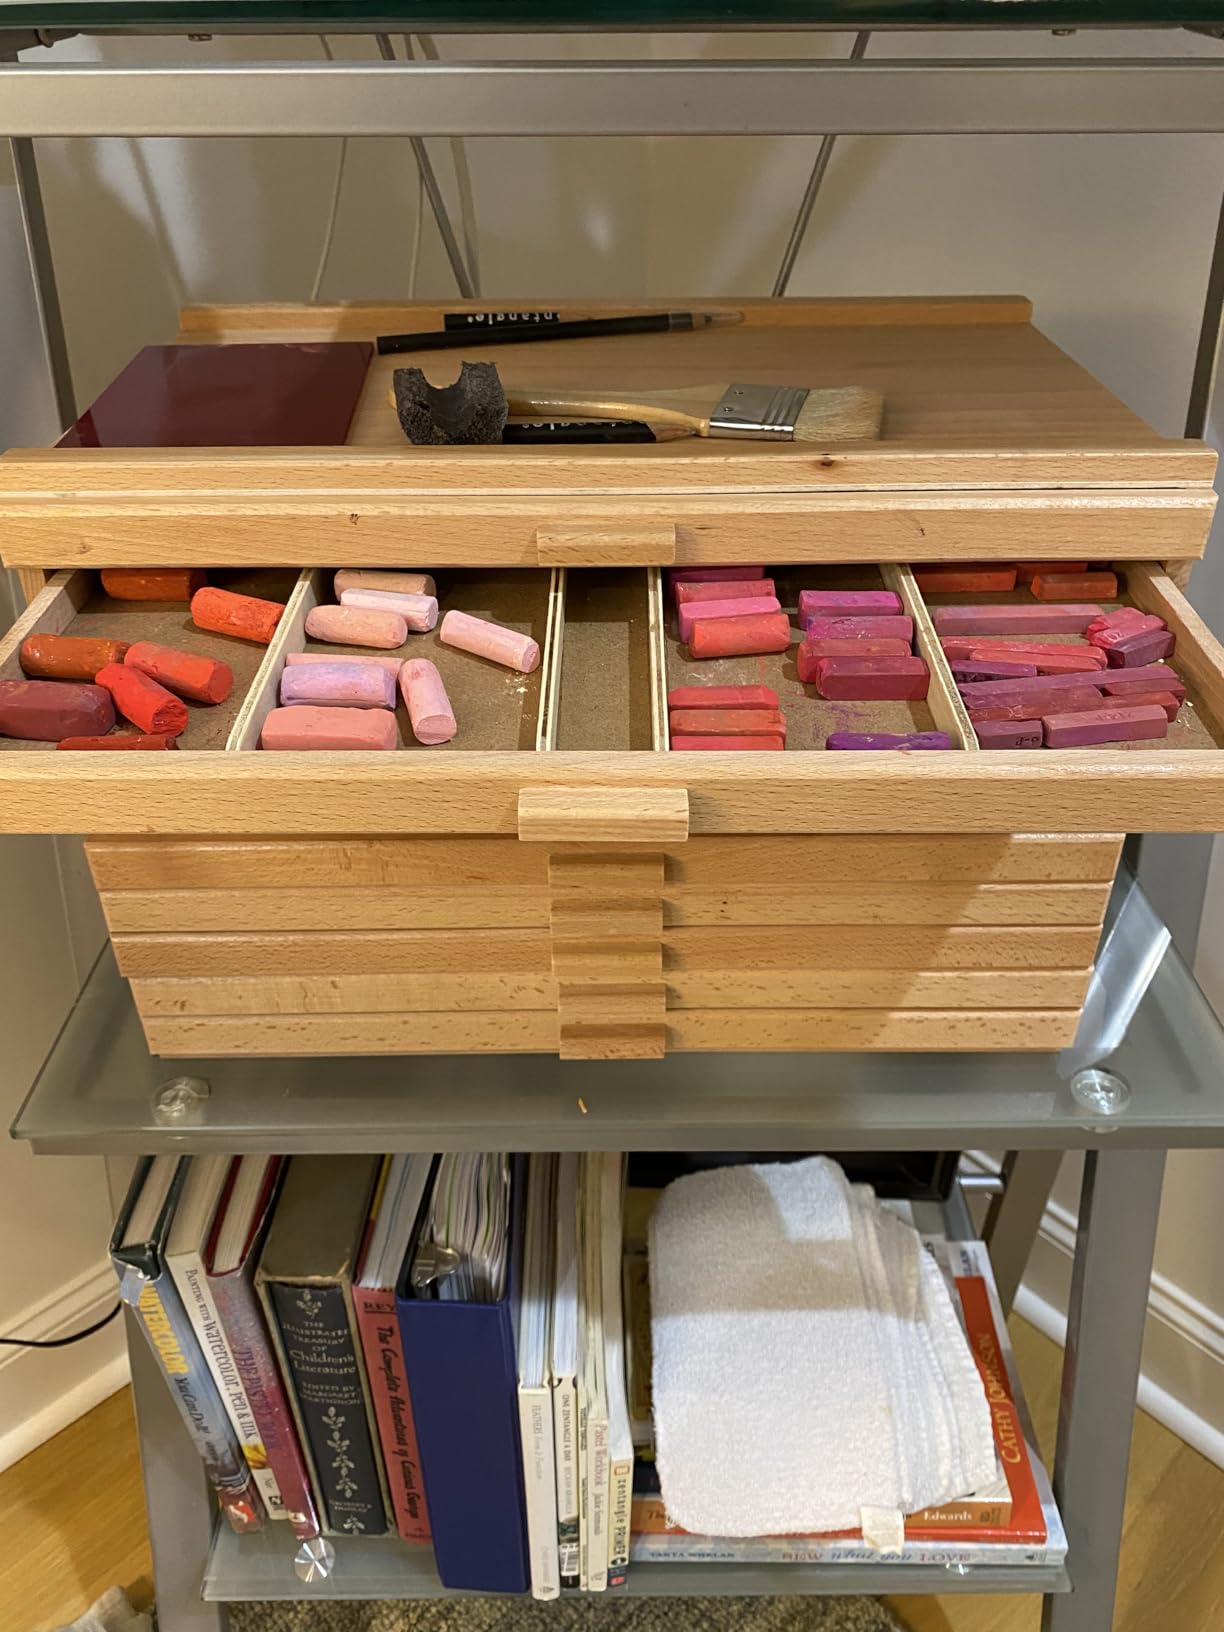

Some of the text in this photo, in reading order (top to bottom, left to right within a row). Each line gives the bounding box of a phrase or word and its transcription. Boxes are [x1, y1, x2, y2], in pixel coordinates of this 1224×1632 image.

[377, 1326, 394, 1344] The
[293, 1360, 357, 1374] Literature
[378, 1348, 401, 1393] Complete
[976, 1332, 1022, 1464] CATHY JOHNSON
[237, 1412, 253, 1421] &
[923, 1511, 973, 1522] Edwards
